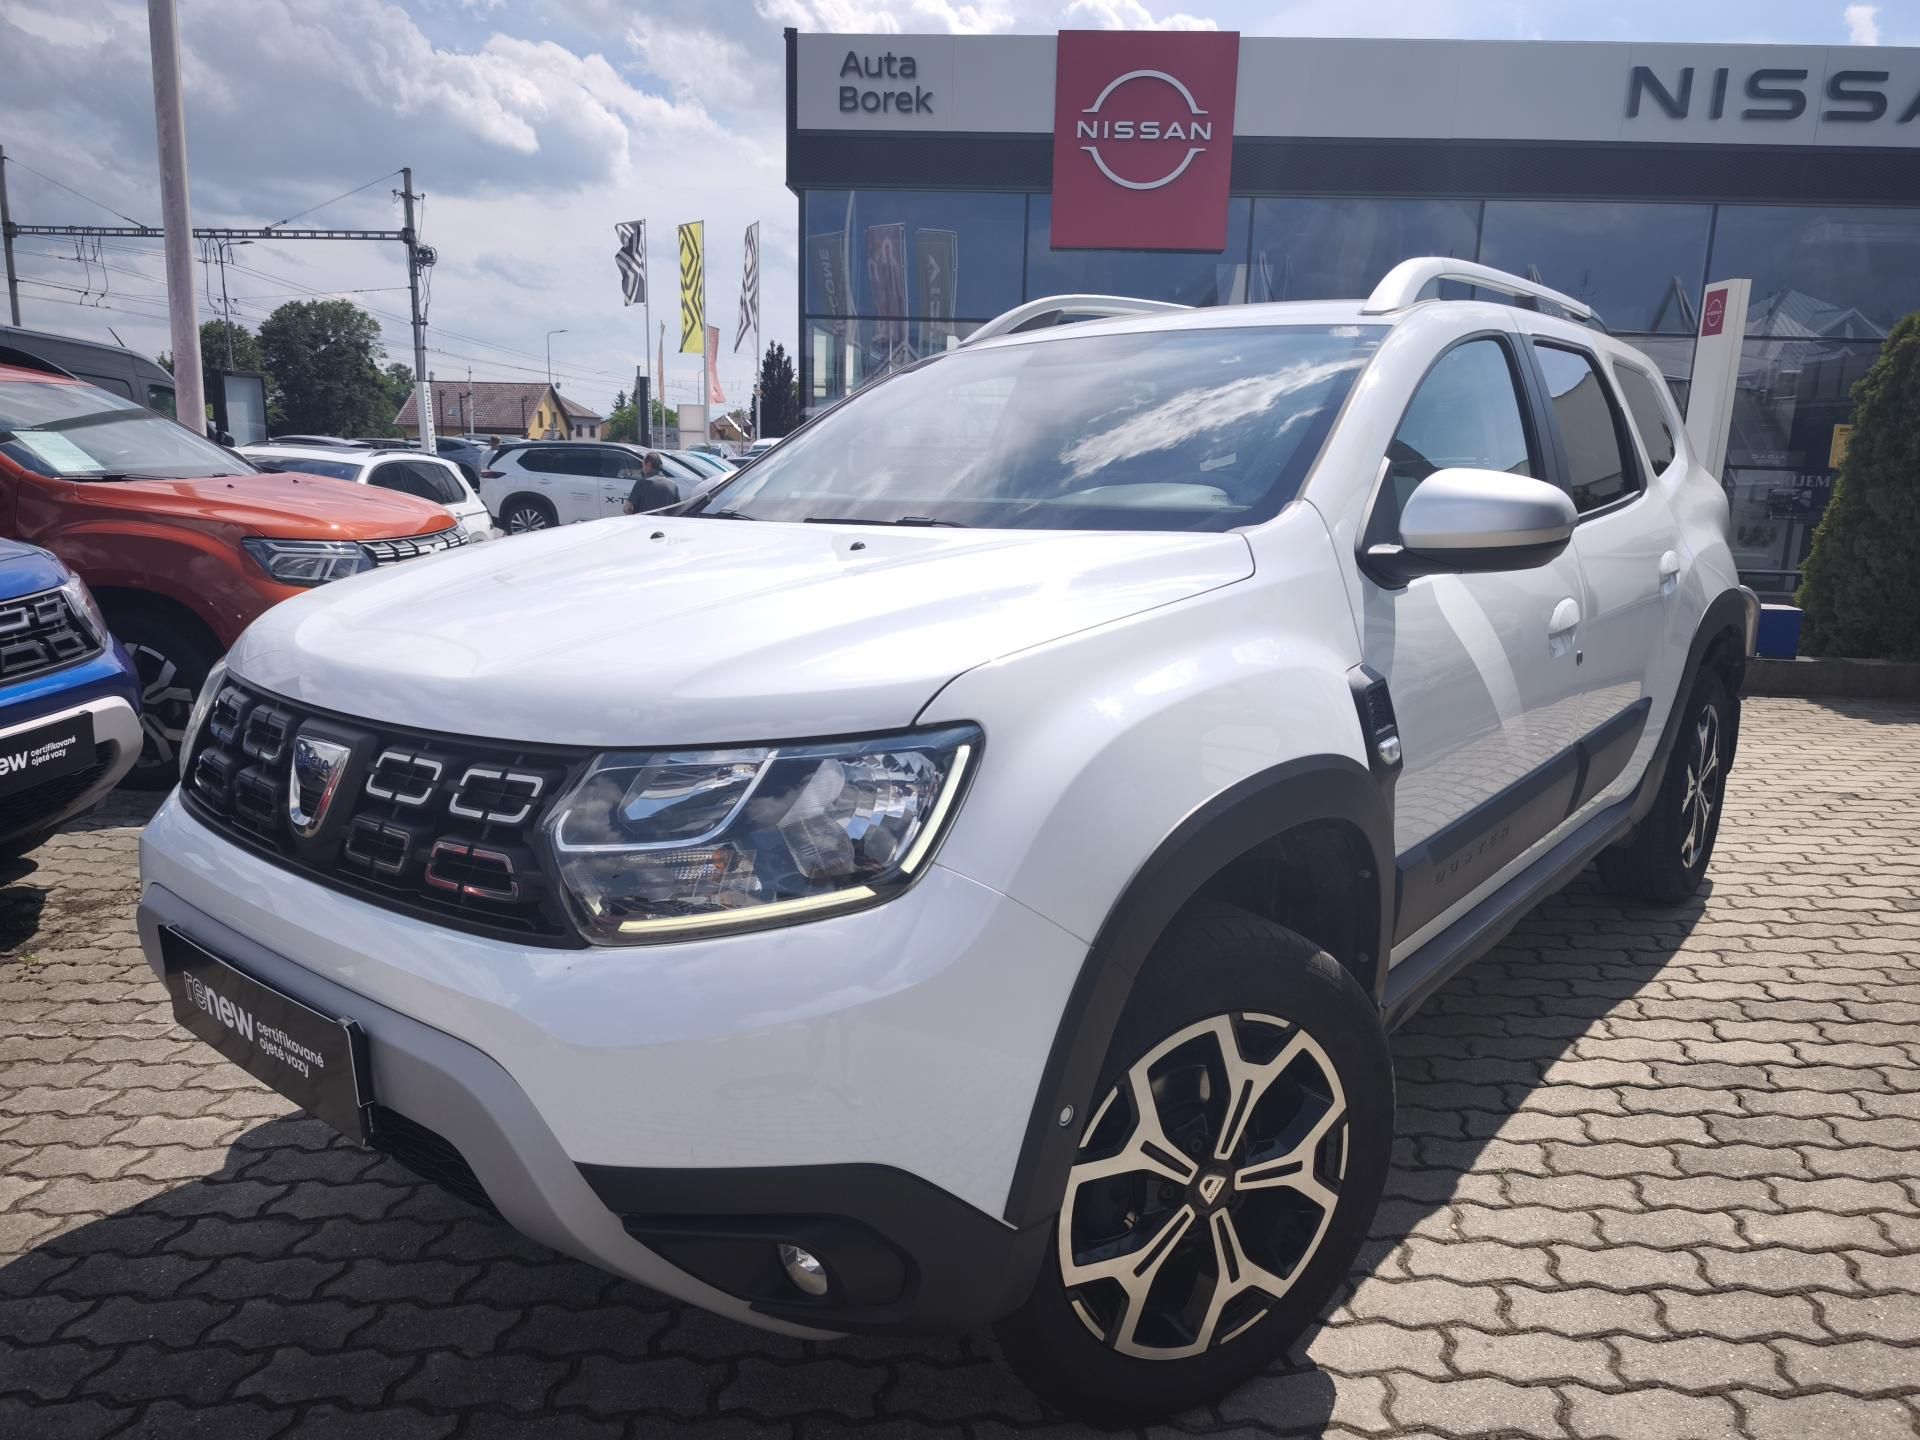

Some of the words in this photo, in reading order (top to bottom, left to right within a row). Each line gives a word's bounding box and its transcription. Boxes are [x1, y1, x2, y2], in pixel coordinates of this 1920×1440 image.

[839, 51, 917, 79] Auta
[839, 86, 933, 114] Borek
[1077, 120, 1213, 141] NISSAN
[606, 496, 624, 504] X-T
[31, 735, 76, 757] certifikované
[31, 754, 50, 766] ojeté
[50, 748, 66, 759] vozy
[184, 971, 254, 1042] renew
[256, 1021, 324, 1068] certifikované
[259, 1038, 285, 1061] ojeté
[285, 1053, 310, 1078] vozy
